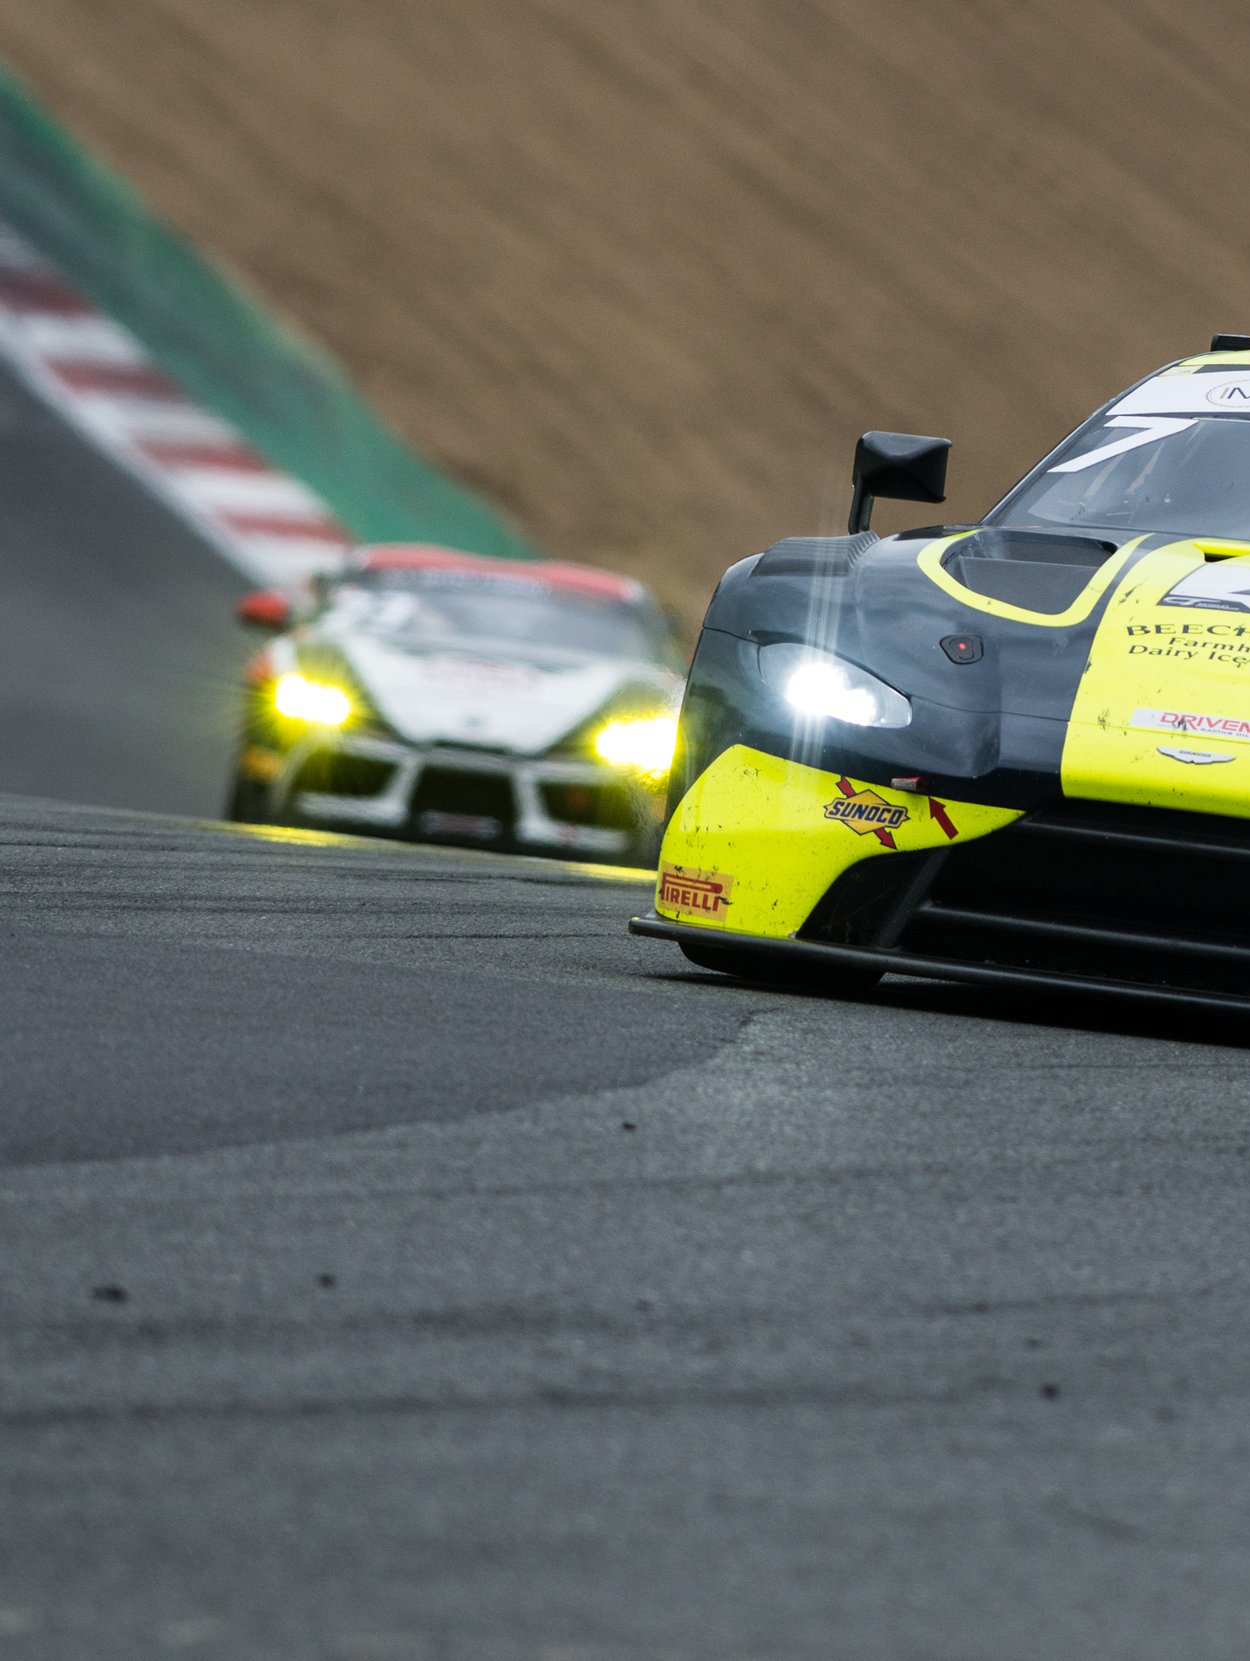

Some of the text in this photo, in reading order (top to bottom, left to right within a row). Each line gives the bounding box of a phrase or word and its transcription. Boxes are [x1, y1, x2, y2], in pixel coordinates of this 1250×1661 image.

[1047, 416, 1199, 472] 7
[1128, 644, 1195, 661] Dairy
[1207, 650, 1248, 664] Ice
[828, 800, 902, 826] SUNOCO
[659, 871, 724, 912] PIRELLI
